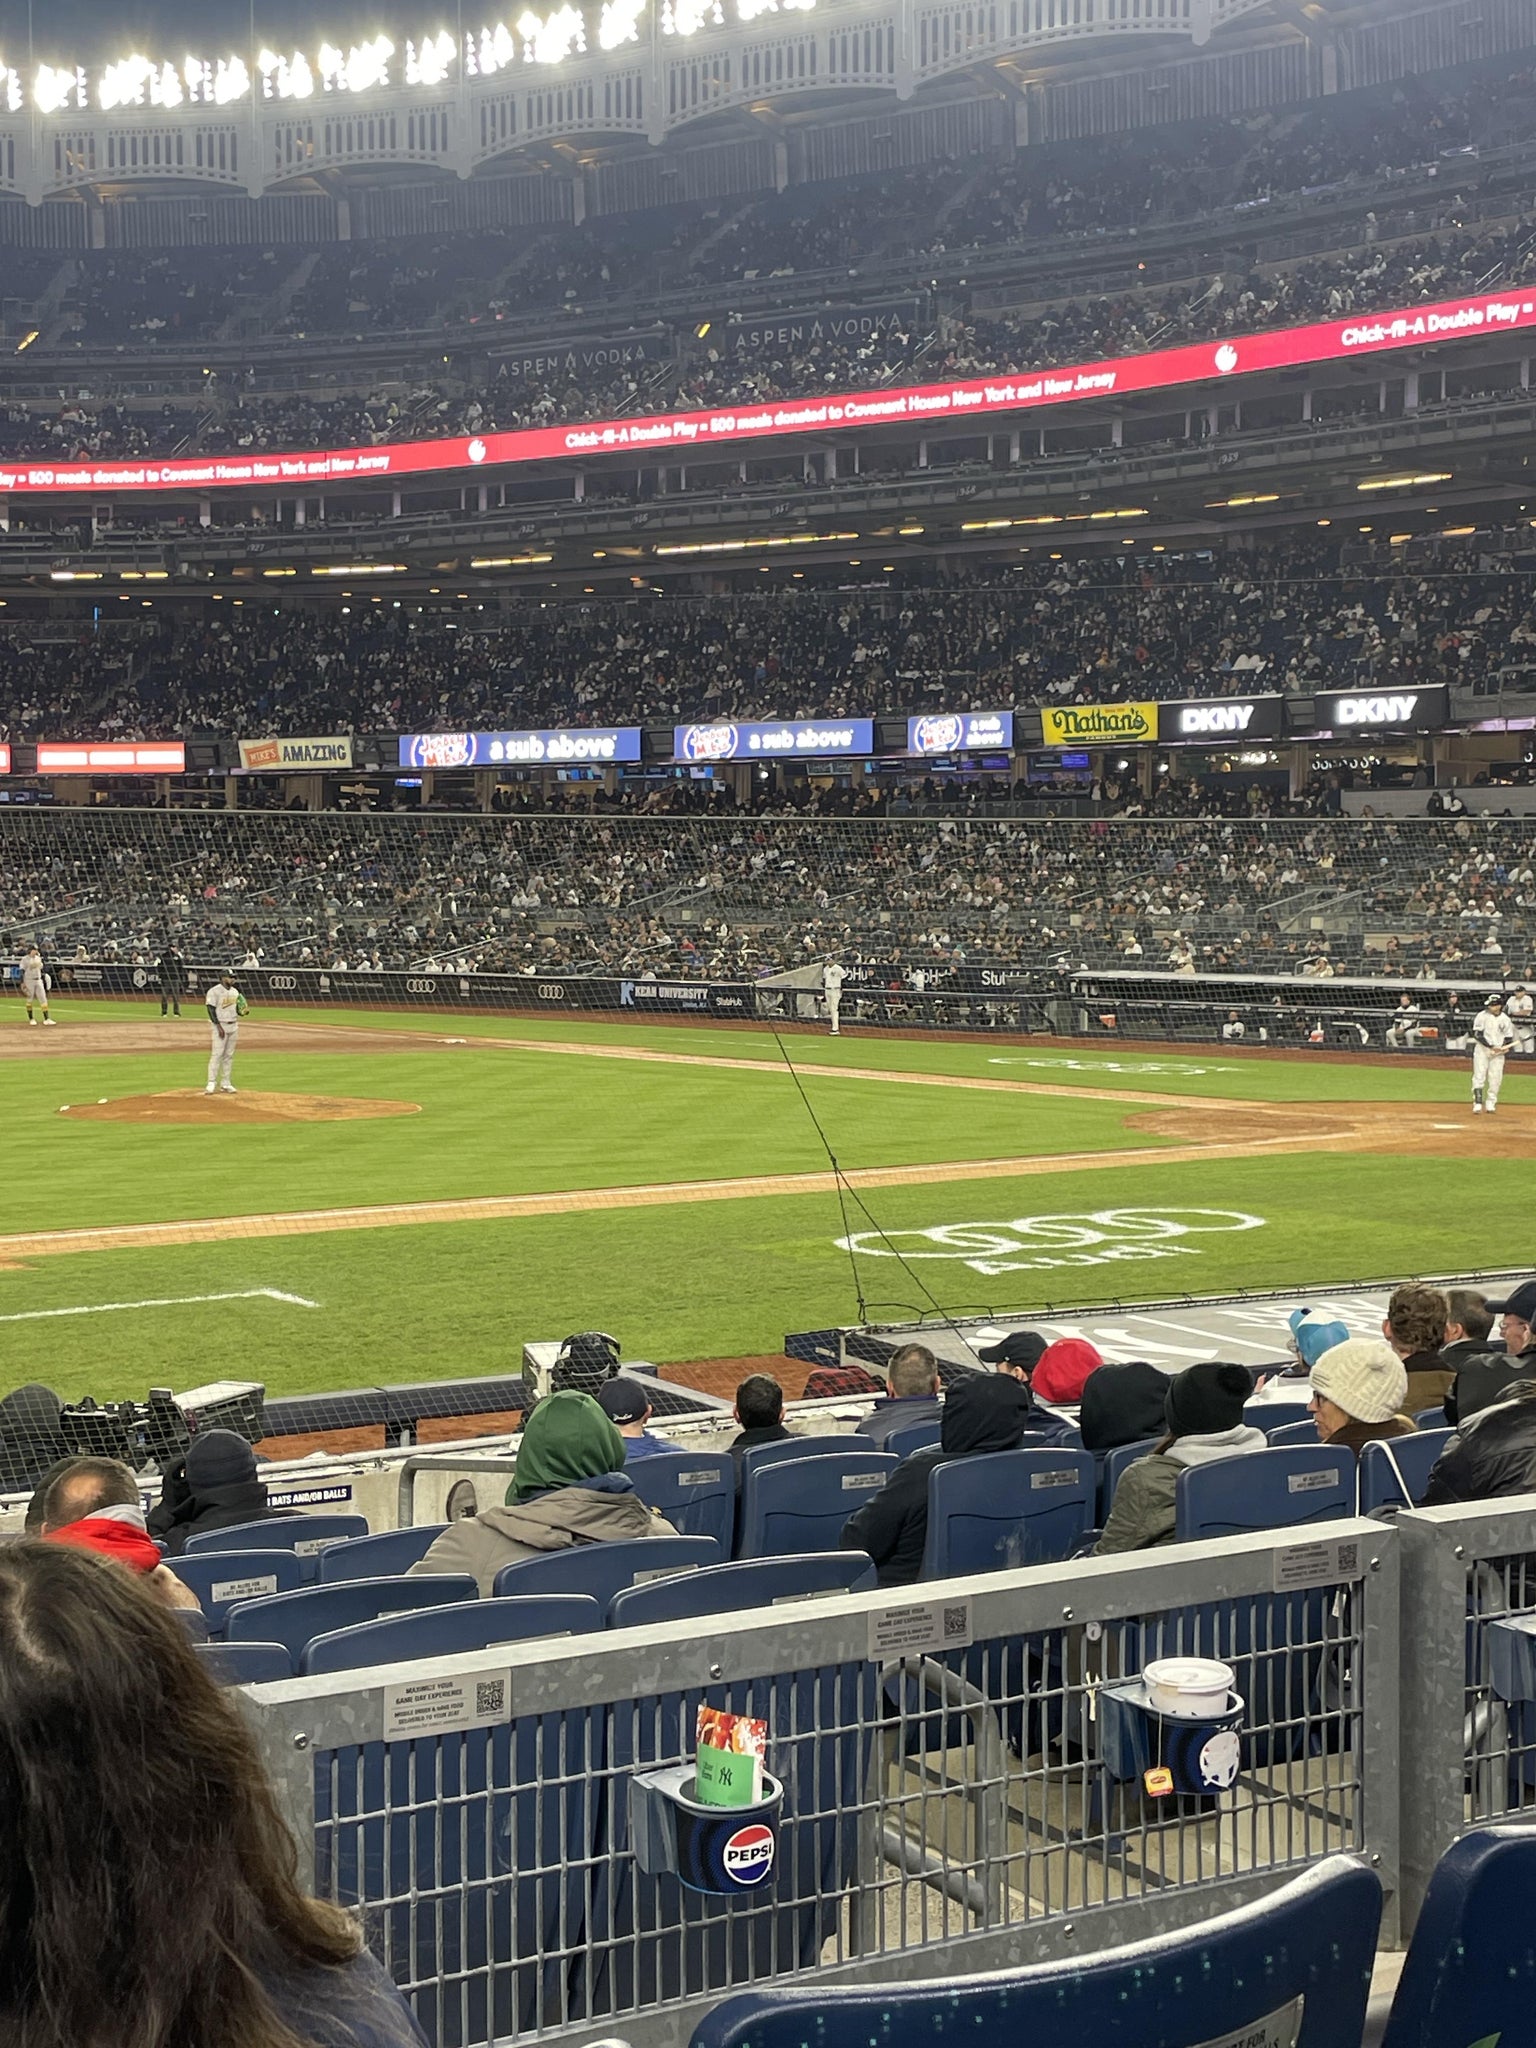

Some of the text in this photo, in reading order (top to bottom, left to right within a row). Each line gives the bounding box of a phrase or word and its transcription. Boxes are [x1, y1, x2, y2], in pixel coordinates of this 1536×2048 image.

[736, 326, 803, 349] ASPEN
[831, 312, 901, 337] VODKA
[1428, 308, 1484, 332] Double
[1487, 303, 1519, 322] Play
[499, 356, 558, 377] ASPEN
[583, 345, 646, 368] VODKA
[630, 424, 672, 441] Double
[828, 406, 843, 420] to
[844, 398, 906, 418] Covenant
[909, 395, 950, 411] House
[953, 391, 983, 406] New
[984, 385, 1015, 402] York
[1017, 381, 1042, 399] and
[1044, 379, 1073, 395] New
[1074, 373, 1116, 390] Jersey
[1052, 708, 1149, 735] Nathan's
[1182, 705, 1254, 732] DKNY
[1336, 696, 1418, 725] DKNY
[489, 735, 613, 760] a sub above
[750, 728, 853, 749] a sub above
[283, 744, 347, 762] AMAZING
[635, 986, 657, 997] KEAN
[659, 987, 708, 999] UNIVERSITY
[271, 1488, 347, 1506] BATS AND/OR BALLS
[727, 1843, 772, 1862] PEPSI
